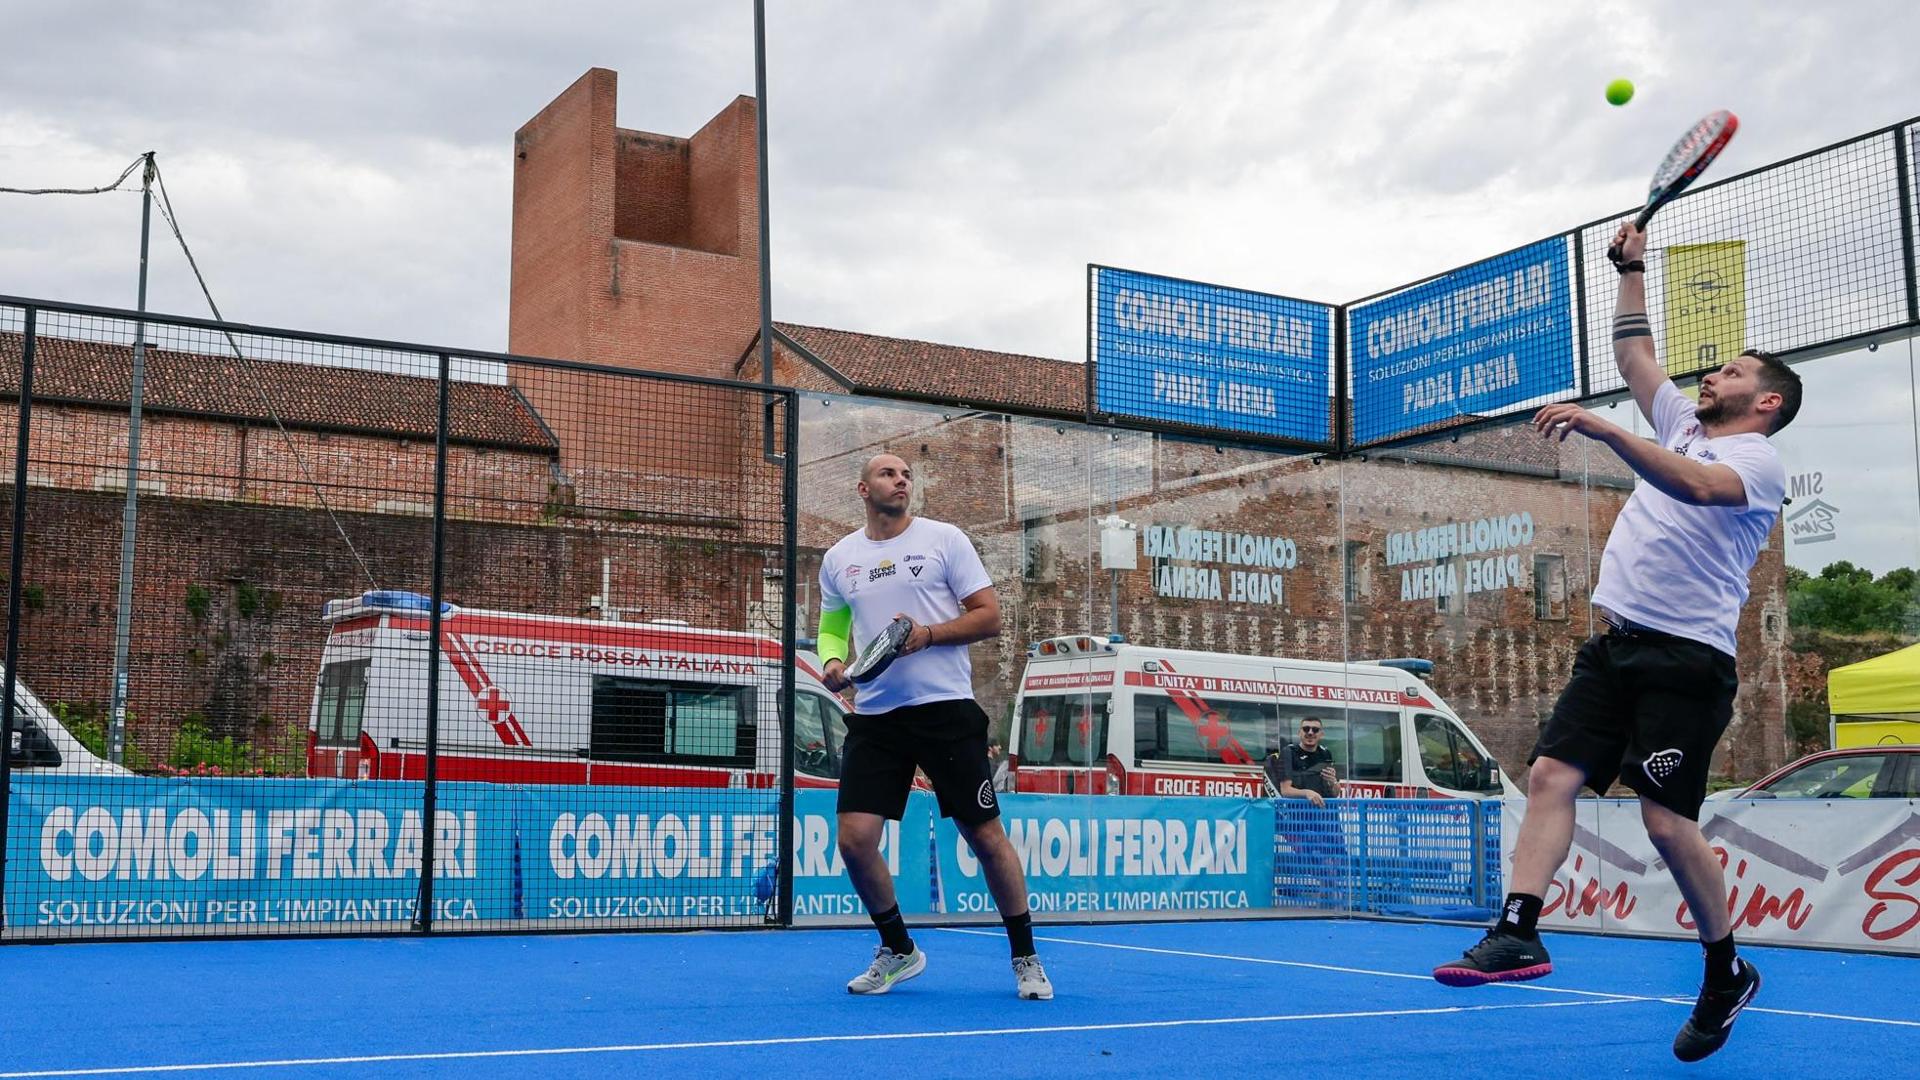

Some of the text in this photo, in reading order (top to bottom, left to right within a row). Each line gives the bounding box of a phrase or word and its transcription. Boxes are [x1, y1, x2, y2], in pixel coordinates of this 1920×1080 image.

[1115, 289, 1313, 359] COMOLI FERRARI
[1368, 259, 1552, 359] COMOLI FERRARI
[1115, 340, 1186, 363] SOLUZION
[1369, 354, 1430, 383] SOLUZIONI
[1434, 346, 1454, 363] PER
[1154, 369, 1277, 418] PADEL ARENA
[1403, 352, 1519, 415] PADEL ARENA
[869, 563, 897, 575] street
[869, 570, 897, 583] games
[474, 639, 757, 675] CROCE ROSSA ITALIANA
[1155, 675, 1397, 703] UNITA' DI RIANIMAZIONE E NEONATALE
[1155, 778, 1200, 796] CROCE
[1205, 780, 1253, 798] ROSSA
[40, 806, 477, 881] COMOLI FERRARI
[550, 812, 900, 879] COMOLI FERRI
[956, 818, 1247, 878] CMOLI FERRARI
[38, 898, 478, 925] SOLUZIONI PER L'IMPIANTISICA
[550, 896, 676, 918] SOLUZIONI
[683, 895, 723, 916] PER
[957, 890, 1249, 913] SOLONI PER L'IMPIANTISTICA
